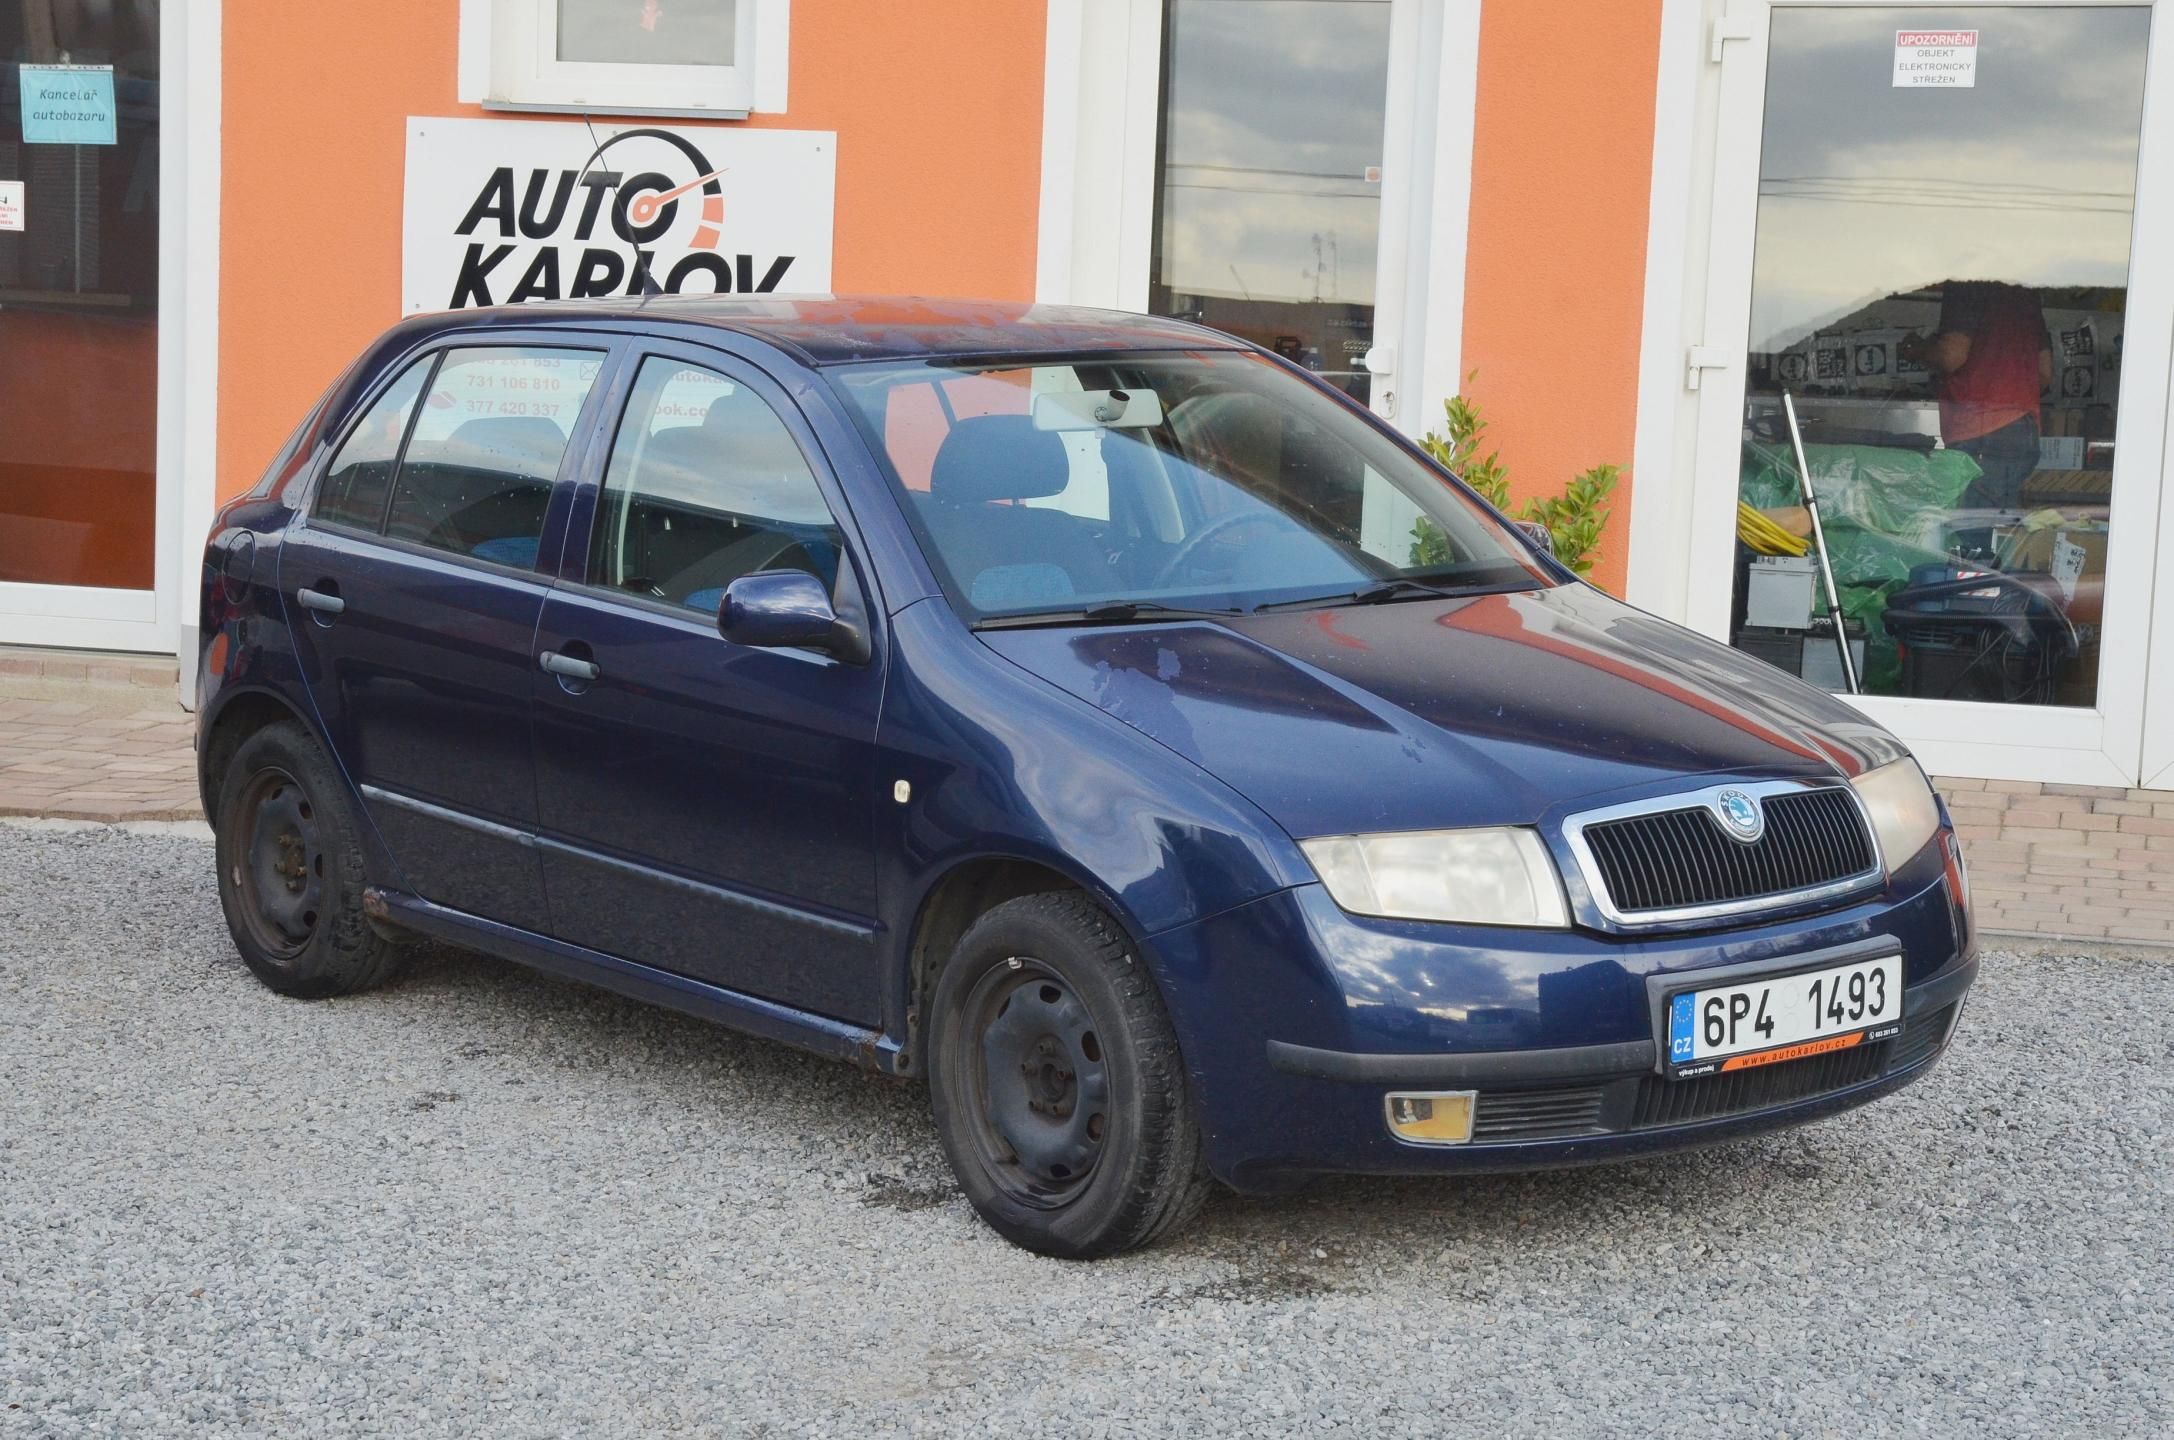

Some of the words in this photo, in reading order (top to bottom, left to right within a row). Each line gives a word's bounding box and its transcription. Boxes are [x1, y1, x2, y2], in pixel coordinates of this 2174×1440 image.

[1917, 49, 1955, 58] OBJEKT
[1899, 62, 1972, 71] ELEKTRONICKY
[33, 109, 105, 122] autobazaru
[454, 167, 679, 245] AUTO
[466, 375, 494, 388] 731
[501, 376, 528, 390] 106
[532, 378, 560, 391] 810
[466, 400, 495, 413] 377
[500, 401, 527, 415] 420
[532, 404, 560, 417] 337
[1674, 1036, 1691, 1054] CZ
[1703, 988, 1775, 1048] 6P4
[1808, 967, 1886, 1030] 1493
[1742, 1039, 1846, 1066] www.autokarlov.cz
